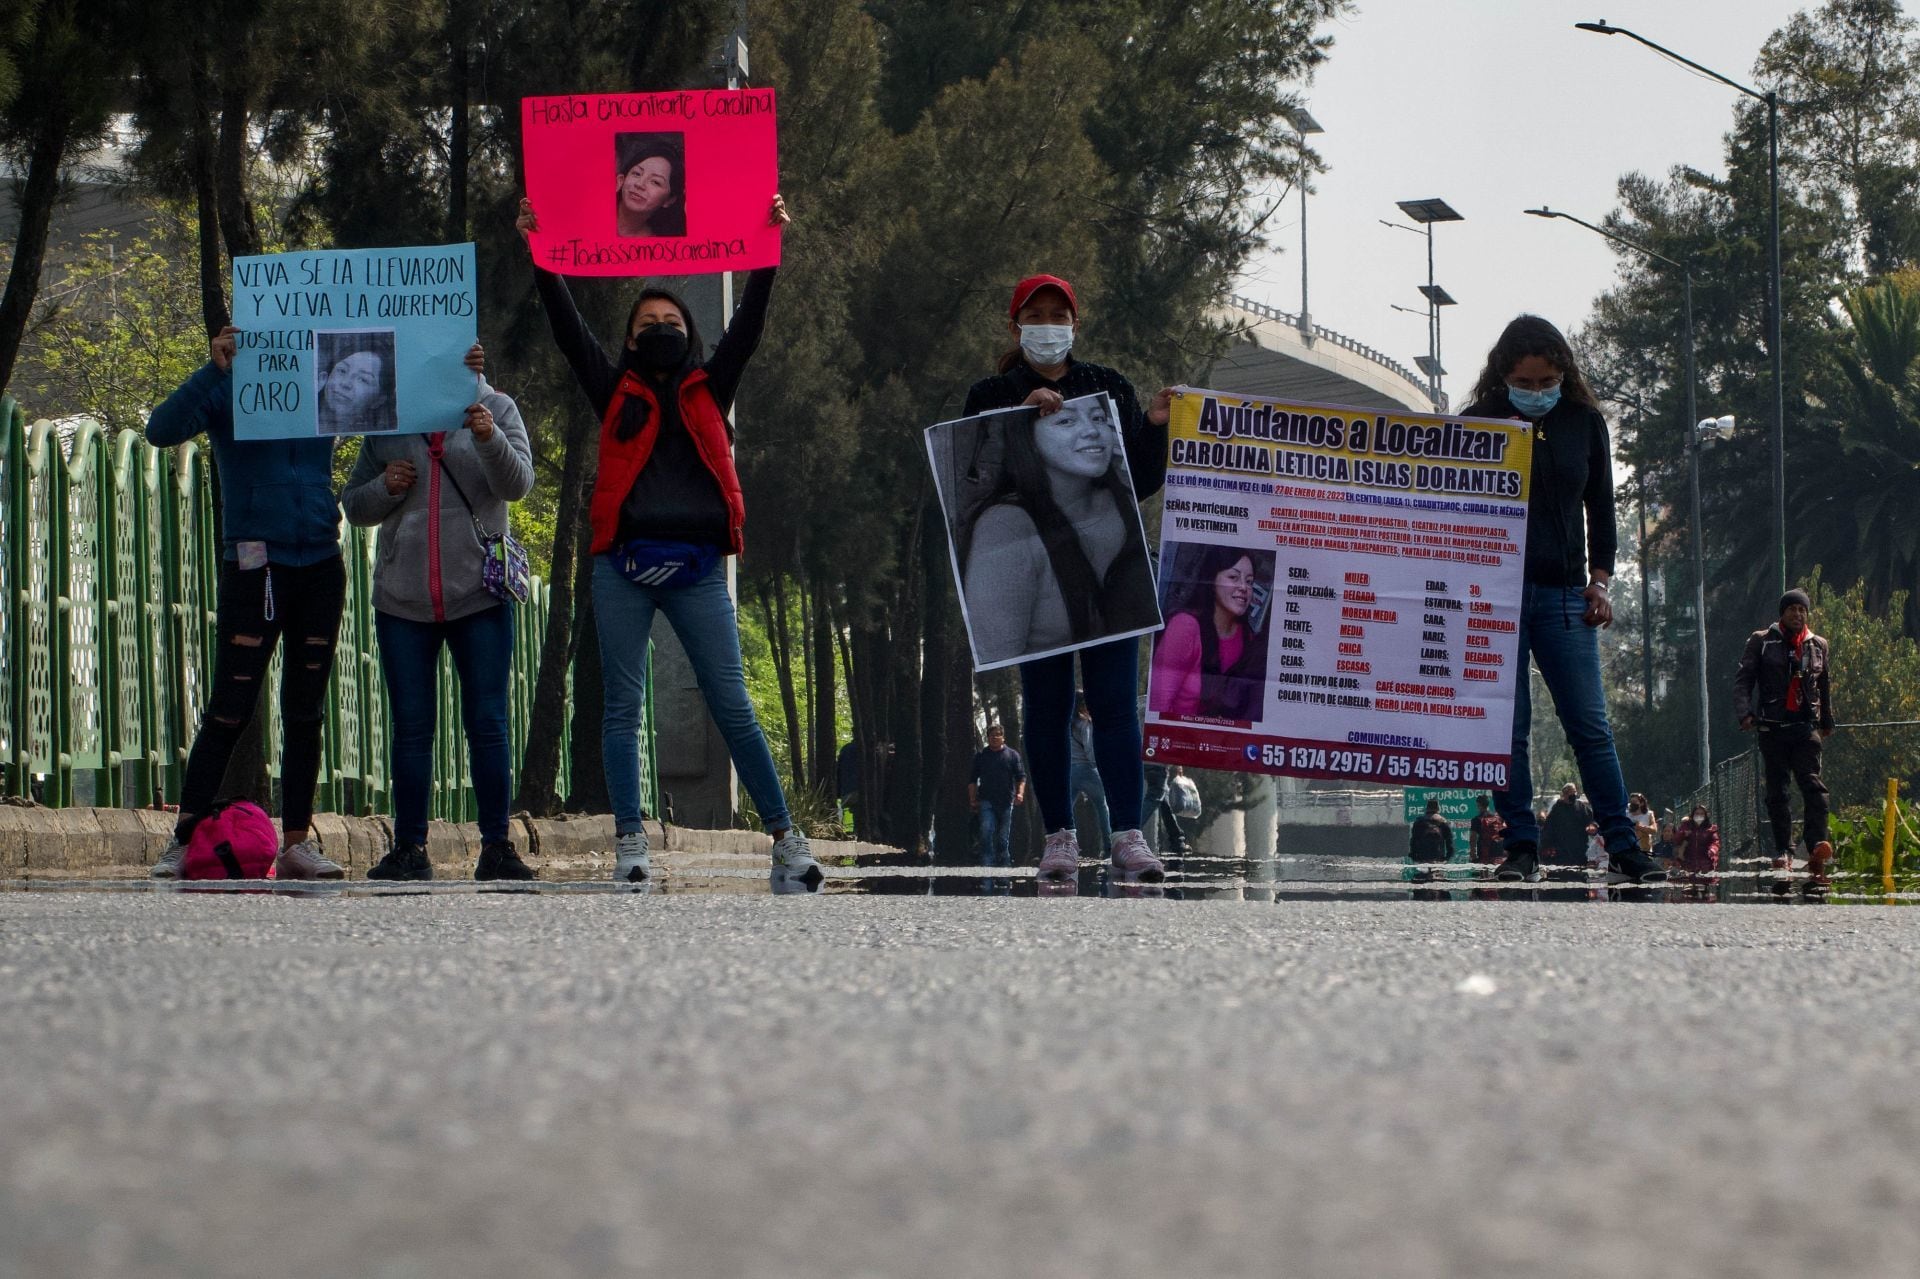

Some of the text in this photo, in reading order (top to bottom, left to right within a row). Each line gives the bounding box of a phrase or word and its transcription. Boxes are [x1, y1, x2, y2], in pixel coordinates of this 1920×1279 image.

[532, 91, 772, 124] Hasta encontrarte Carolina
[237, 254, 464, 287] VIVA SE LA LLEVARON
[253, 291, 473, 318] Y VIVA LA QUEREMOS
[238, 329, 314, 350] JUSTICIA
[258, 353, 300, 372] PARA
[239, 381, 300, 414] CARO
[1199, 397, 1507, 461] Ayúdanos a Localizar
[1172, 440, 1521, 496] CAROLINA LETICIA ISLAS DORANTES
[1166, 499, 1191, 512] SEÑAS
[1167, 475, 1175, 484] SE
[1177, 475, 1184, 485] LE
[1185, 475, 1197, 486] VIÓ
[1198, 478, 1212, 488] POR
[1213, 477, 1238, 491] ÚLTIMA
[1239, 481, 1252, 492] VEZ
[1252, 483, 1260, 493] EL
[1261, 483, 1273, 494] DÍA
[1275, 485, 1283, 495] 27
[1284, 486, 1294, 496] DE
[1294, 487, 1316, 498] ENERO
[1317, 490, 1326, 499] DE
[1327, 491, 1346, 501] 2023
[1346, 492, 1354, 502] EN
[1356, 493, 1382, 504] CENTRO
[1463, 503, 1489, 514] CIUDAD
[1490, 505, 1499, 515] DE
[1499, 504, 1525, 517] MÉXICO
[1176, 517, 1238, 534] Y/O VESTIMENTA
[1270, 507, 1298, 518] CICATRIZ
[1339, 513, 1367, 524] ABDOMEN
[1411, 520, 1439, 531] CICATRIZ
[1440, 523, 1452, 533] POR
[1257, 520, 1281, 530] TATUAJE
[1282, 522, 1290, 531] EN
[1291, 522, 1326, 534] ANTEBRAZO
[1327, 525, 1359, 537] IZQUIERDO
[1360, 529, 1378, 539] PARTE
[1413, 534, 1421, 543] EN
[1422, 534, 1442, 545] FORMA
[1443, 537, 1451, 546] DE
[1452, 537, 1482, 549] MARIPOSA
[1483, 540, 1502, 551] COLOR
[1288, 535, 1309, 546] NEGRO
[1310, 538, 1323, 547] CON
[1323, 539, 1349, 550] MANGAS
[1401, 546, 1431, 557] PANTALÓN
[1432, 549, 1452, 559] LARGO
[1452, 551, 1465, 560] LISO
[1466, 552, 1480, 562] GRIS
[1481, 554, 1501, 565] CLARO
[1288, 566, 1369, 584] SEXO: MUJER
[1287, 584, 1376, 602] COMPLEXIÓN: DELGADA
[1425, 580, 1481, 595] EDAD: 30
[1286, 602, 1397, 622] TEZ: MORENA MEDIA
[1424, 597, 1463, 610] ESTATURA:
[1283, 619, 1363, 636] FRENTE: MEDIA
[1423, 613, 1516, 632] CARA: REDONDEADA
[1281, 637, 1362, 654] BOCA: CHICA
[1422, 630, 1489, 647] NARIZ: RECTA
[1280, 654, 1305, 667] CEJAS:
[1420, 647, 1504, 664] LABIOS: DELGADOS
[1419, 663, 1498, 680] MENTÓN: ANGULAR
[1279, 672, 1303, 684] COLOR
[1304, 674, 1310, 685] Y
[1311, 675, 1327, 686] TIPO
[1328, 677, 1338, 688] DE
[1338, 678, 1360, 689] OJOS:
[1376, 679, 1394, 692] CAFÉ
[1395, 683, 1426, 696] OSCURO
[1278, 689, 1486, 718] COLOR Y TIPO DE CABELLO: NEGRO LACIO A MEDIA ESPALDA
[1347, 731, 1412, 748] COMUNICARSE
[1262, 744, 1285, 767] 55
[1289, 747, 1327, 770] 1374
[1330, 750, 1373, 774] 2975
[1375, 754, 1386, 776] /
[1388, 755, 1410, 777] 55
[1414, 757, 1459, 781] 4535
